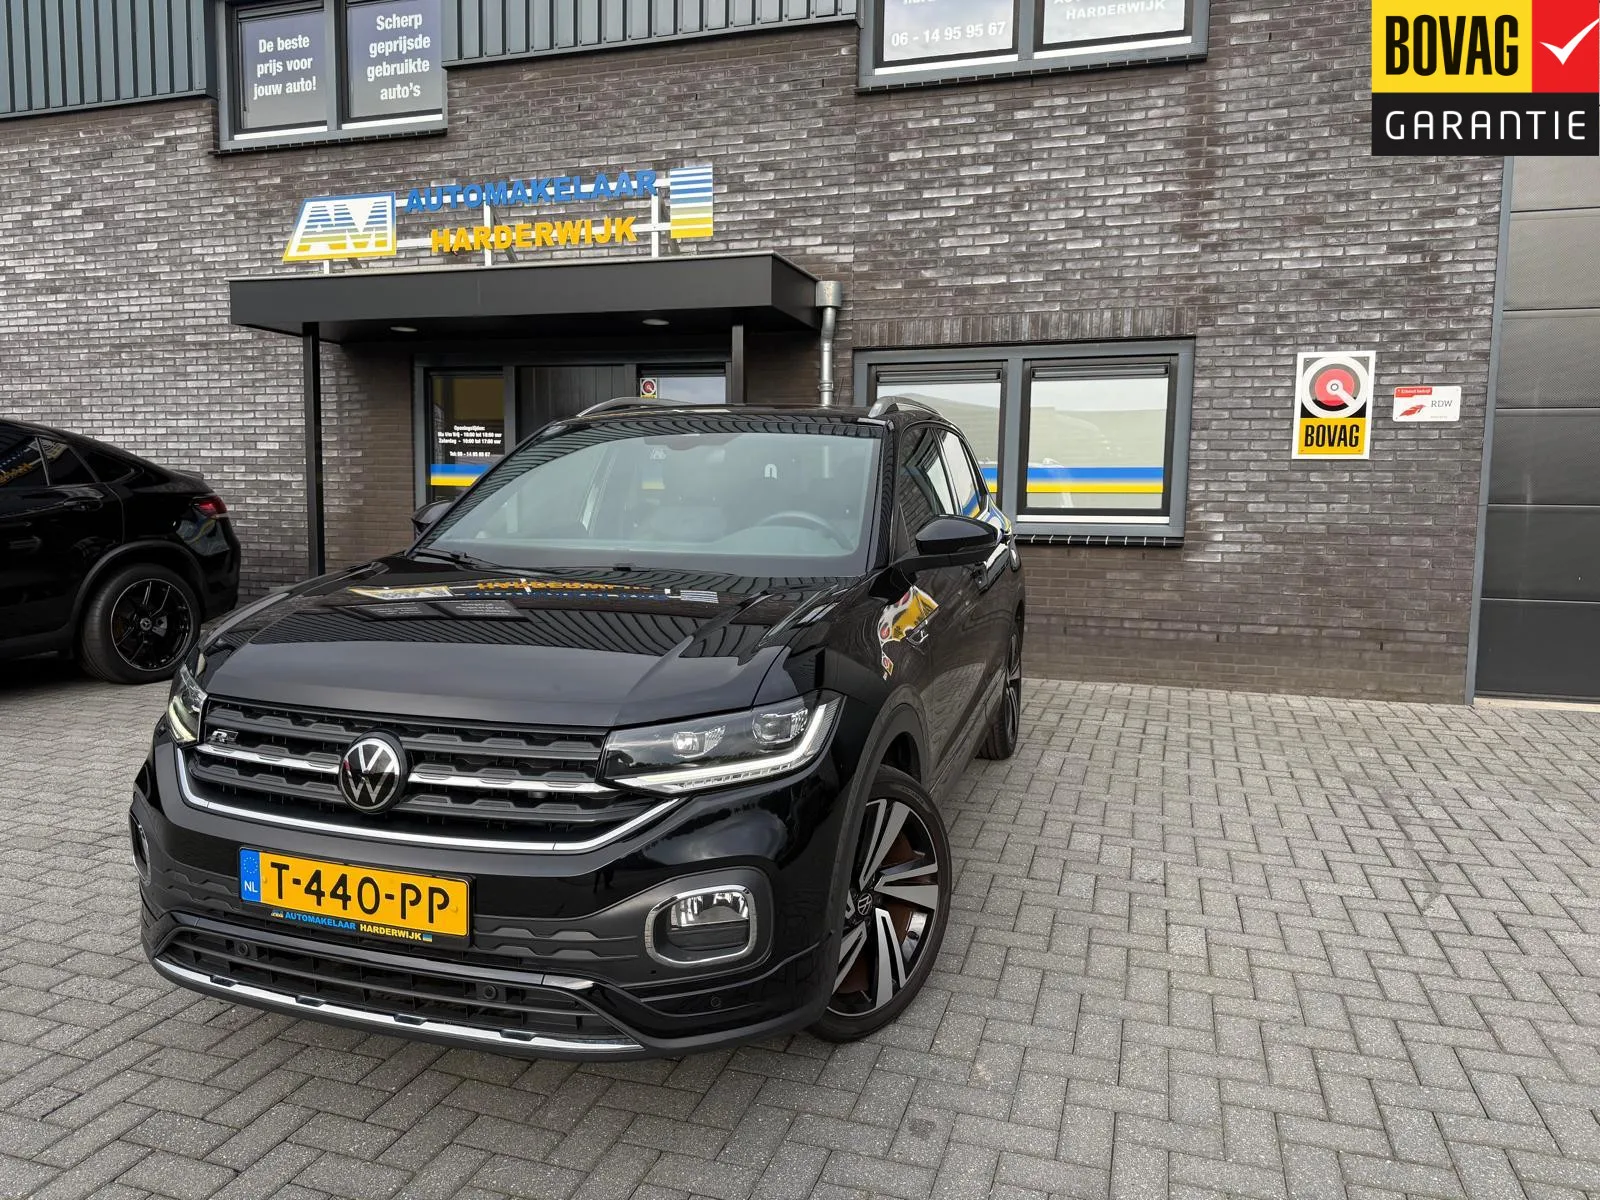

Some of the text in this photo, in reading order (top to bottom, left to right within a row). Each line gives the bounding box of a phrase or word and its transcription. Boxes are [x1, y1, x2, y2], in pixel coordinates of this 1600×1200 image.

[1066, 0, 1166, 20] HARDERWIJK
[376, 13, 423, 31] Scherp
[891, 32, 909, 46] 06
[923, 29, 940, 43] 14
[944, 26, 961, 40] 95
[966, 24, 983, 38] 95
[988, 21, 1005, 35] 67
[258, 34, 310, 53] De beste
[369, 34, 431, 58] geprijsde
[256, 57, 313, 78] prijs voor
[366, 58, 430, 82] gebruikte
[253, 76, 317, 100] jouw auto!
[380, 82, 421, 100] auto's
[405, 170, 657, 213] AUTOMAKELAAR
[431, 216, 638, 253] HARDERWIJK
[1431, 400, 1453, 408] RDW
[1304, 424, 1360, 447] BOVAG
[243, 879, 258, 893] NL
[269, 861, 450, 923] T-440-PP
[285, 911, 357, 930] AUTOMAKELAAR
[360, 923, 422, 941] HARDERWIJK
